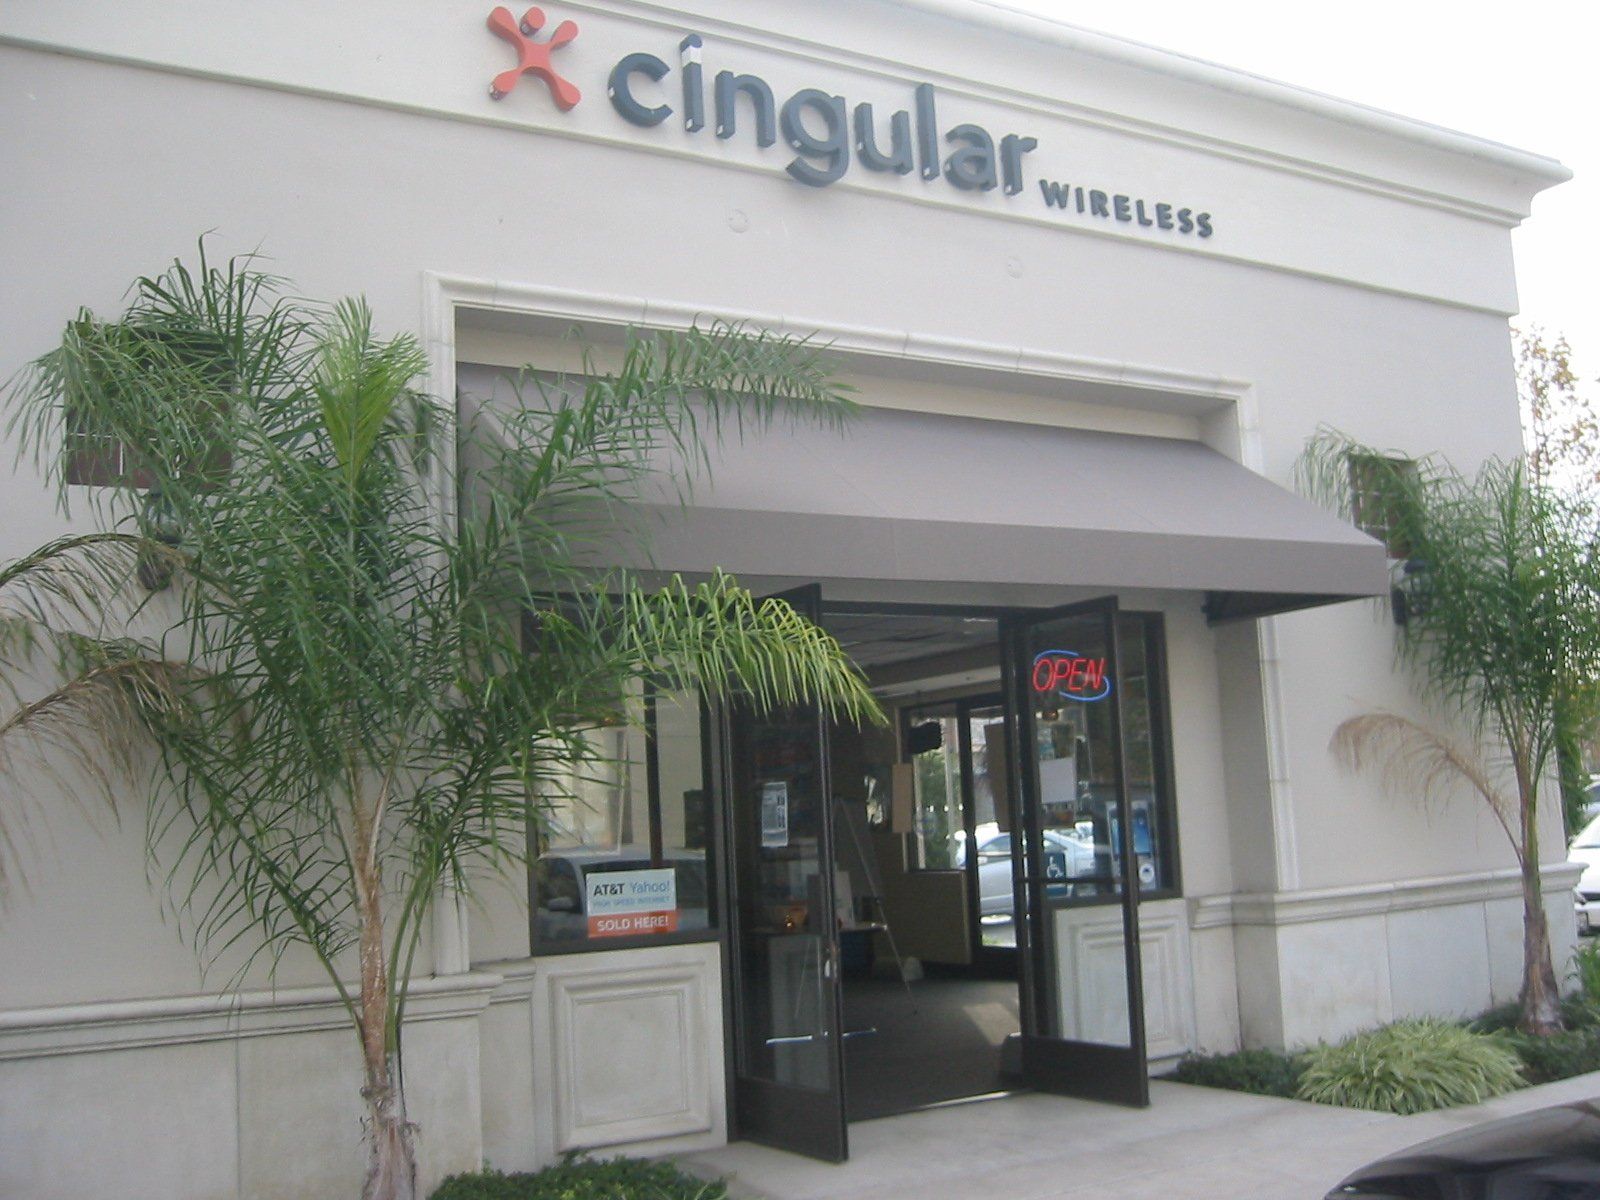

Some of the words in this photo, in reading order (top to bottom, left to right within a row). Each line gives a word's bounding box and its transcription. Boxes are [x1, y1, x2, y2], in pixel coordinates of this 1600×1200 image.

[607, 34, 1038, 196] cingular
[1039, 179, 1213, 238] WIRELESS
[1032, 657, 1105, 692] OPEN
[593, 883, 625, 896] AT&T
[630, 881, 670, 893] Yahoo!
[597, 918, 631, 932] SOLD
[634, 915, 669, 929] HERE!
